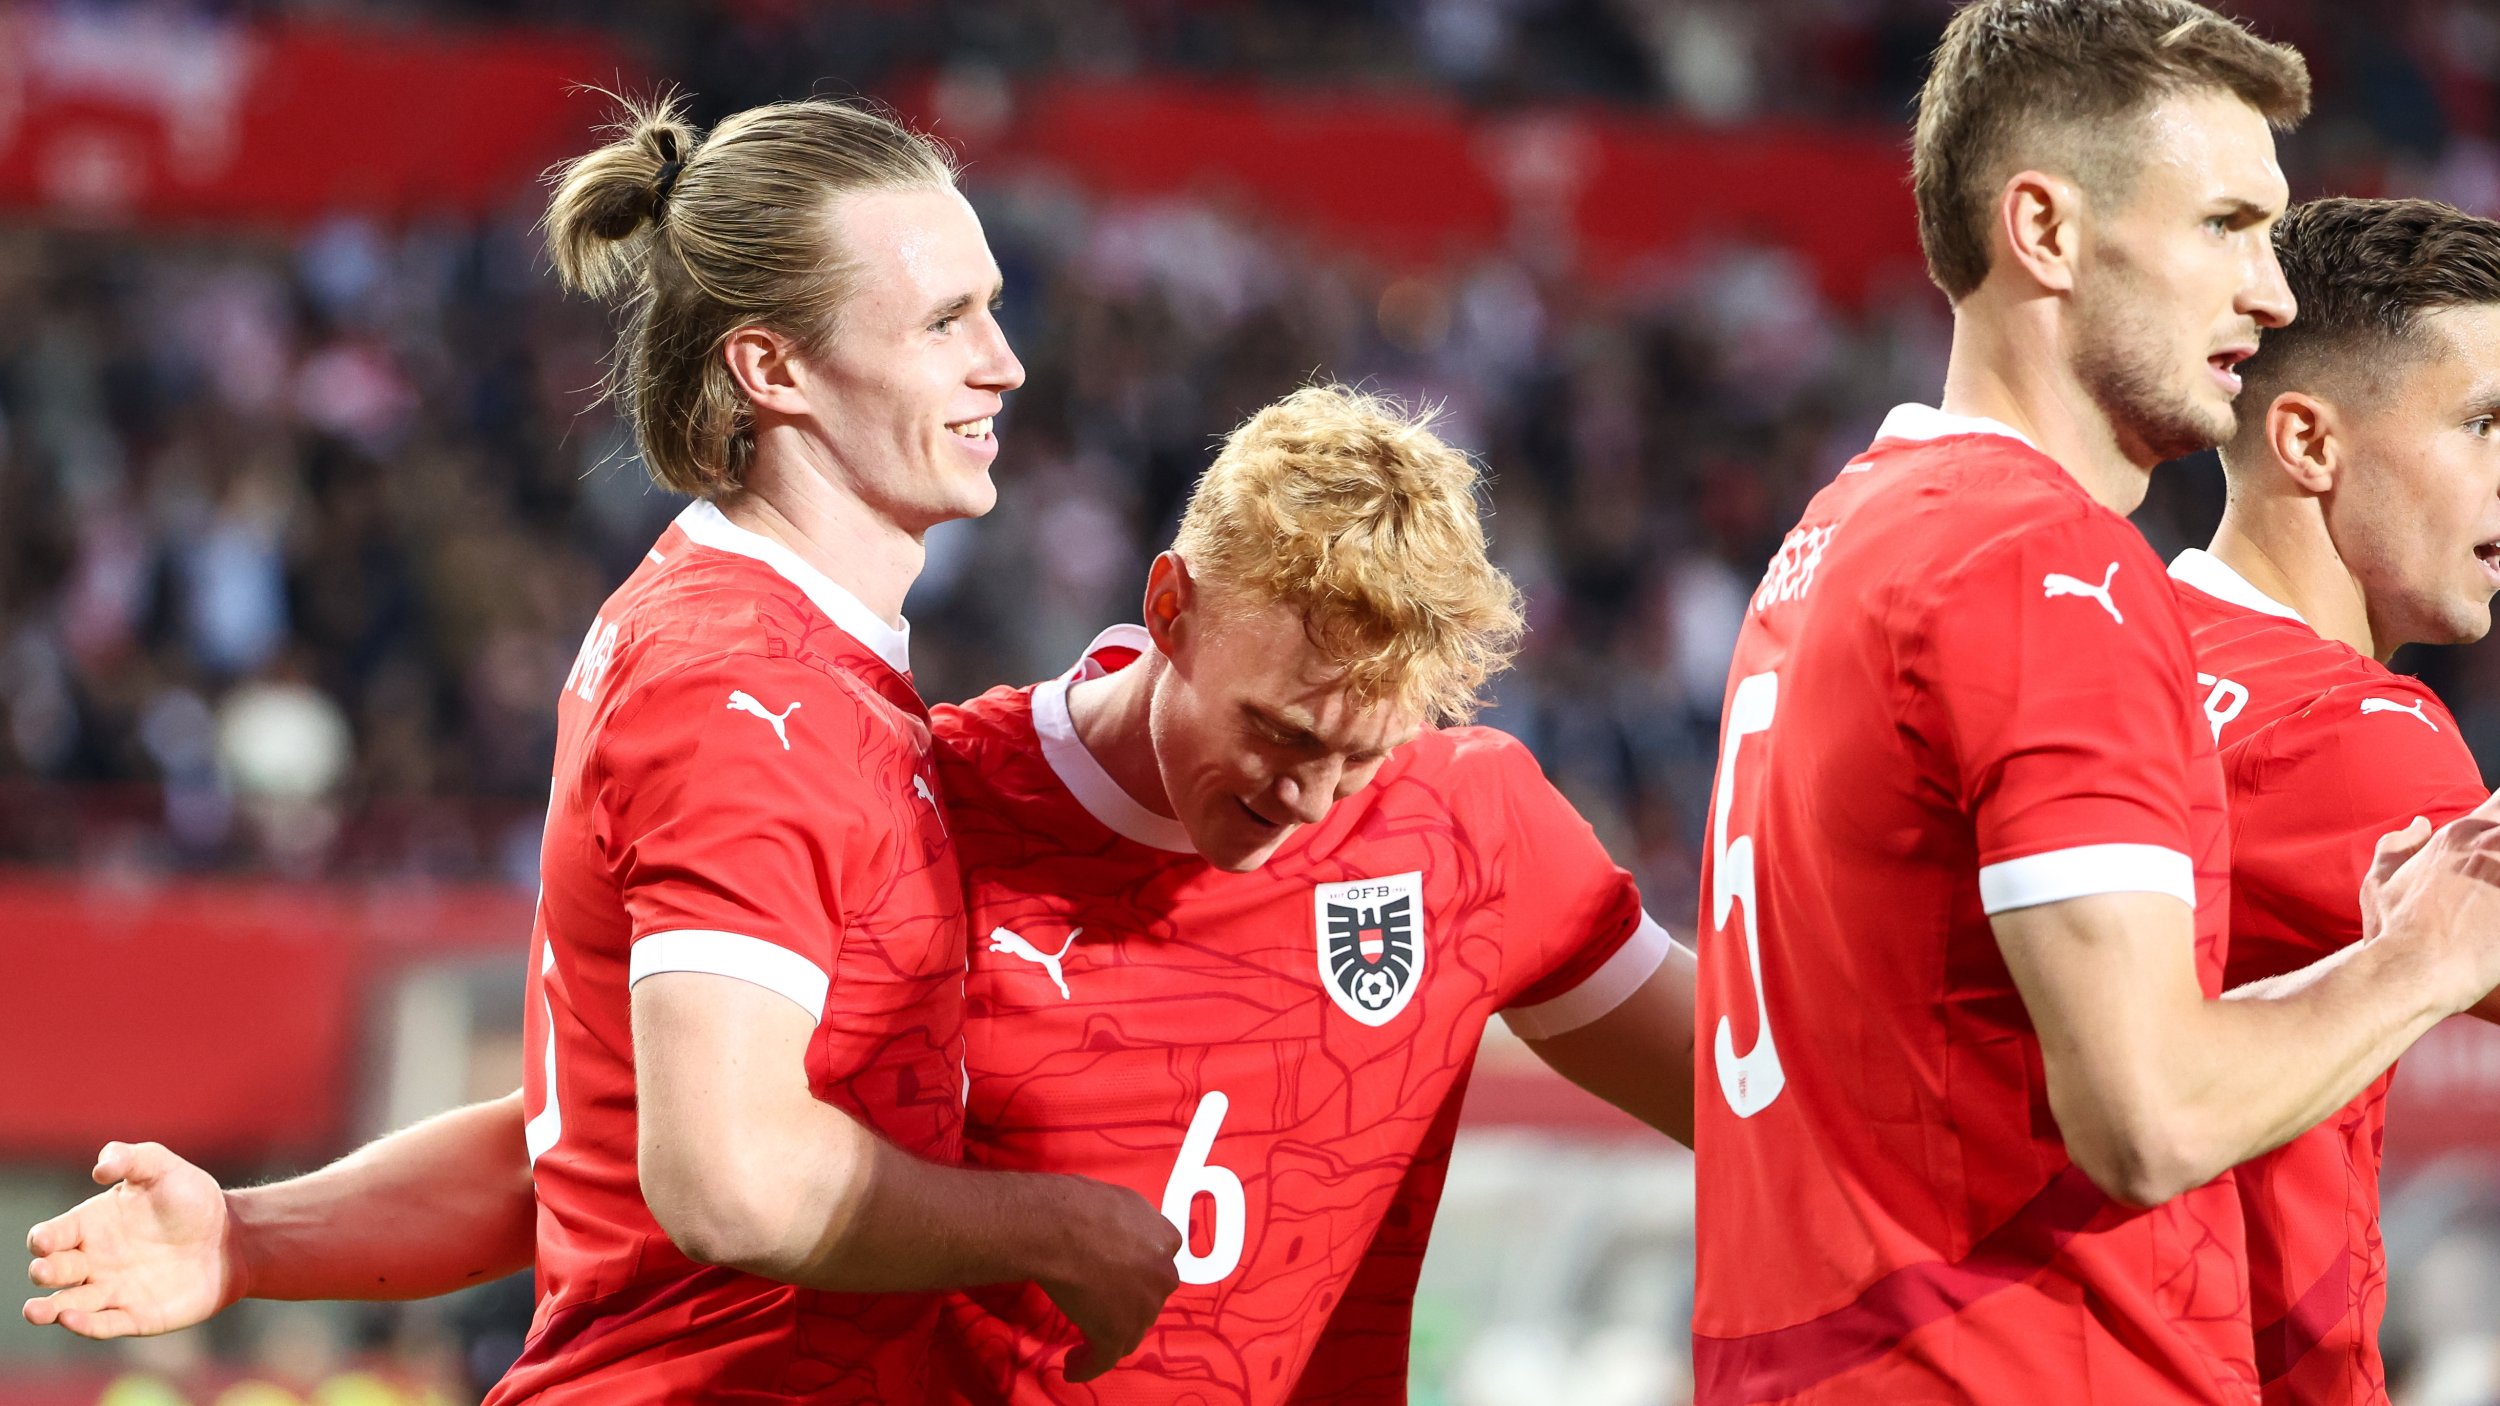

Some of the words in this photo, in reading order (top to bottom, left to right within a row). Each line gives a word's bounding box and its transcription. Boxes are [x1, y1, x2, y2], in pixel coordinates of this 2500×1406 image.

[564, 615, 619, 703] MER
[2196, 671, 2250, 748] R
[1347, 886, 1390, 900] ÖFB
[1713, 670, 1786, 1118] 5
[1160, 1090, 1246, 1285] 6
